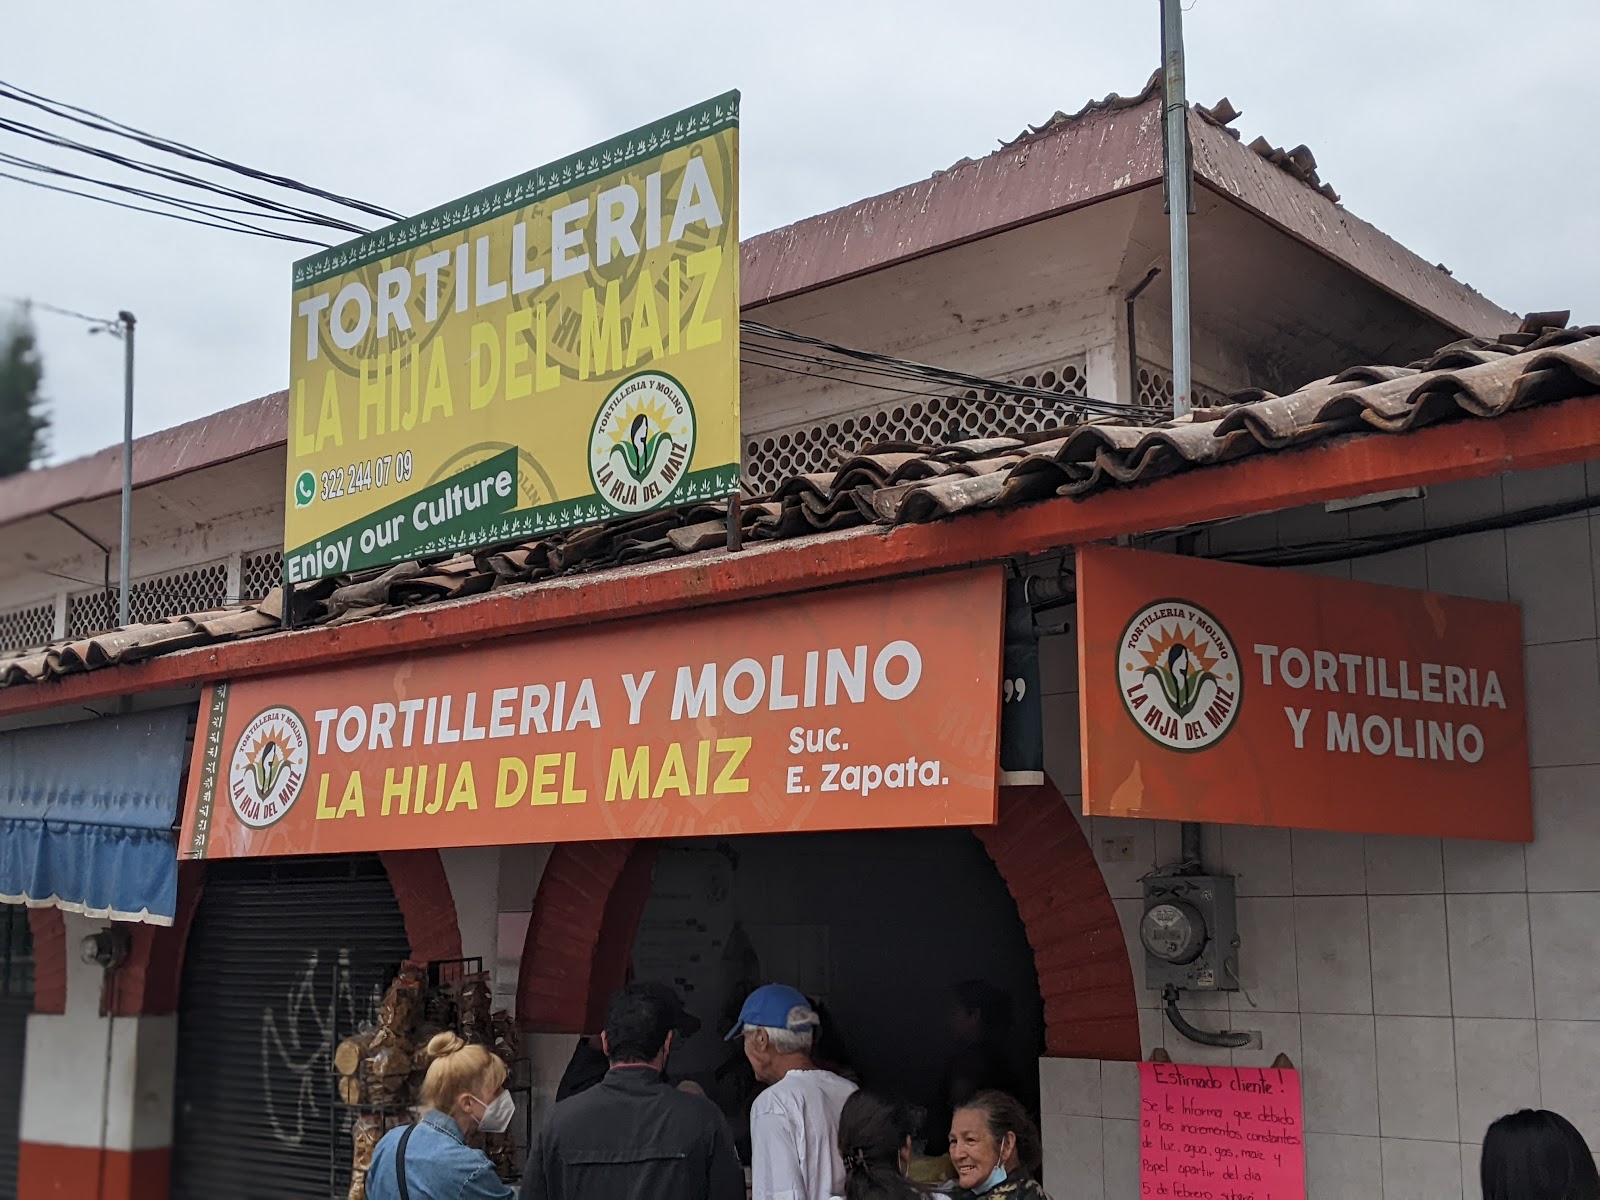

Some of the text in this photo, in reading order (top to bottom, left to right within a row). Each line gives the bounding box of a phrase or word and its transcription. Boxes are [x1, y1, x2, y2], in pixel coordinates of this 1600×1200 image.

[299, 156, 723, 361] TORTILLERIA
[295, 369, 343, 457] LA
[359, 336, 454, 441] HIJA
[470, 303, 561, 411] DEL
[579, 246, 724, 381] MAIZ
[598, 380, 684, 434] TORTILLERIA Y MOLINO
[321, 450, 413, 501] 322 244 07 09
[596, 442, 688, 505] LA HIJA DEL MAIZ
[288, 536, 352, 584] Enjoy
[360, 514, 405, 554] our
[1127, 608, 1228, 660] TORTILLERIA Y MOLINO
[314, 640, 922, 755] TORTILLERIA Y MOLINO
[1254, 643, 1507, 709] TORTILLERIA
[239, 713, 303, 753] TORTILLERIA Y MOLINO
[1127, 683, 1234, 741] LA HIJA DEL MAIZ
[1284, 706, 1485, 763] Y MOLINO
[788, 727, 849, 754] Suc.
[232, 770, 302, 820] LA HIJA DEL MAIZ
[315, 737, 752, 820] LA HIJA DEL MAIZ
[786, 756, 949, 796] E. Zapata.
[1153, 1063, 1222, 1089] Estimado
[1142, 1098, 1158, 1111] Se
[1165, 1093, 1174, 1113] le
[1233, 1110, 1253, 1126] que
[1258, 1105, 1295, 1125] debido
[1144, 1119, 1151, 1128] a
[1159, 1114, 1174, 1131] los
[1246, 1127, 1300, 1145] constantes
[1142, 1135, 1153, 1148] de
[1142, 1182, 1151, 1195] 5
[1156, 1183, 1168, 1195] de
[1222, 1165, 1239, 1180] del
